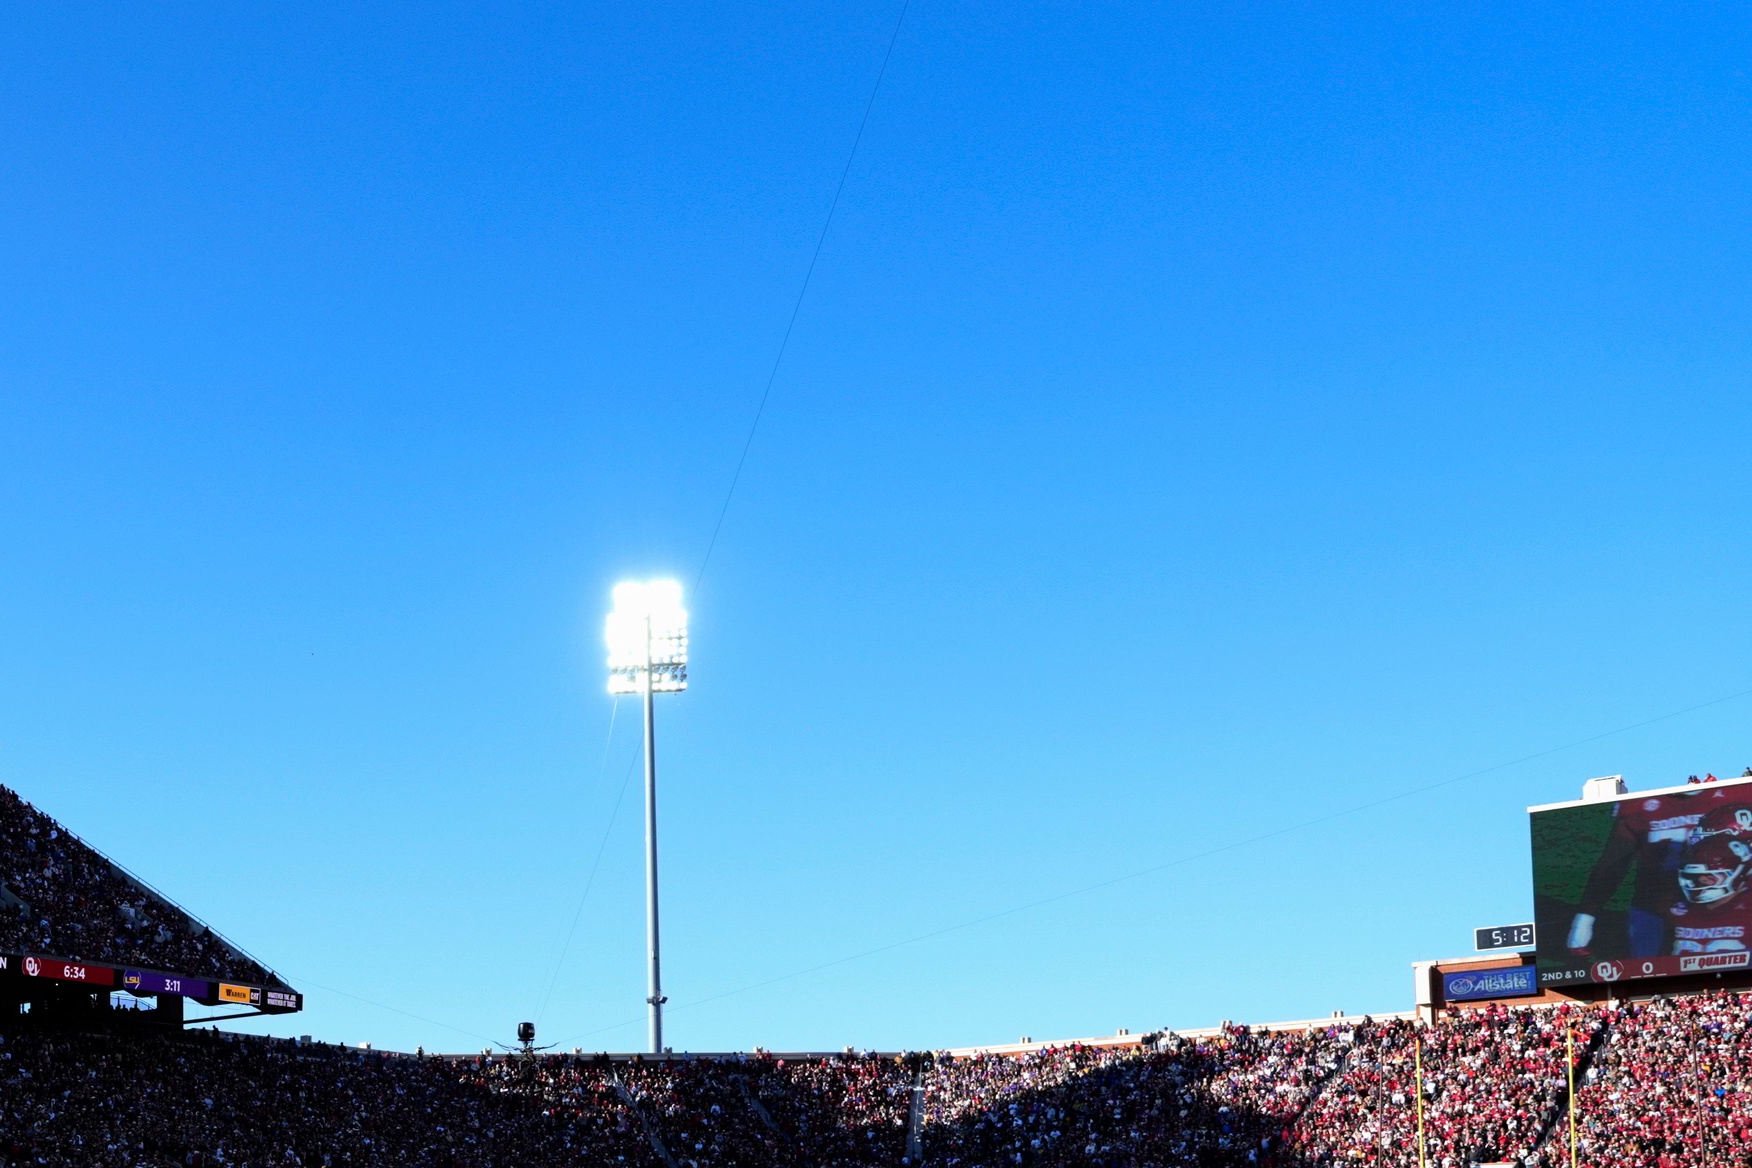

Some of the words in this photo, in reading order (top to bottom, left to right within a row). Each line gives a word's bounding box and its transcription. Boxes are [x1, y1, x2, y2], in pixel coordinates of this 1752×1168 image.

[1491, 927, 1531, 946] 5:12
[1675, 926, 1745, 940] SOONERS
[26, 957, 40, 976] OU
[1642, 961, 1654, 974] 0
[1683, 957, 1696, 969] 1ST
[1698, 953, 1747, 969] QUARTER
[63, 966, 86, 980] 6:34
[1542, 970, 1563, 981] 2ND
[1564, 970, 1572, 980] &
[1574, 969, 1586, 979] 10
[1597, 961, 1620, 982] OU
[124, 976, 140, 985] LSU
[164, 979, 181, 992] 3:11
[1473, 977, 1527, 991] Allstate
